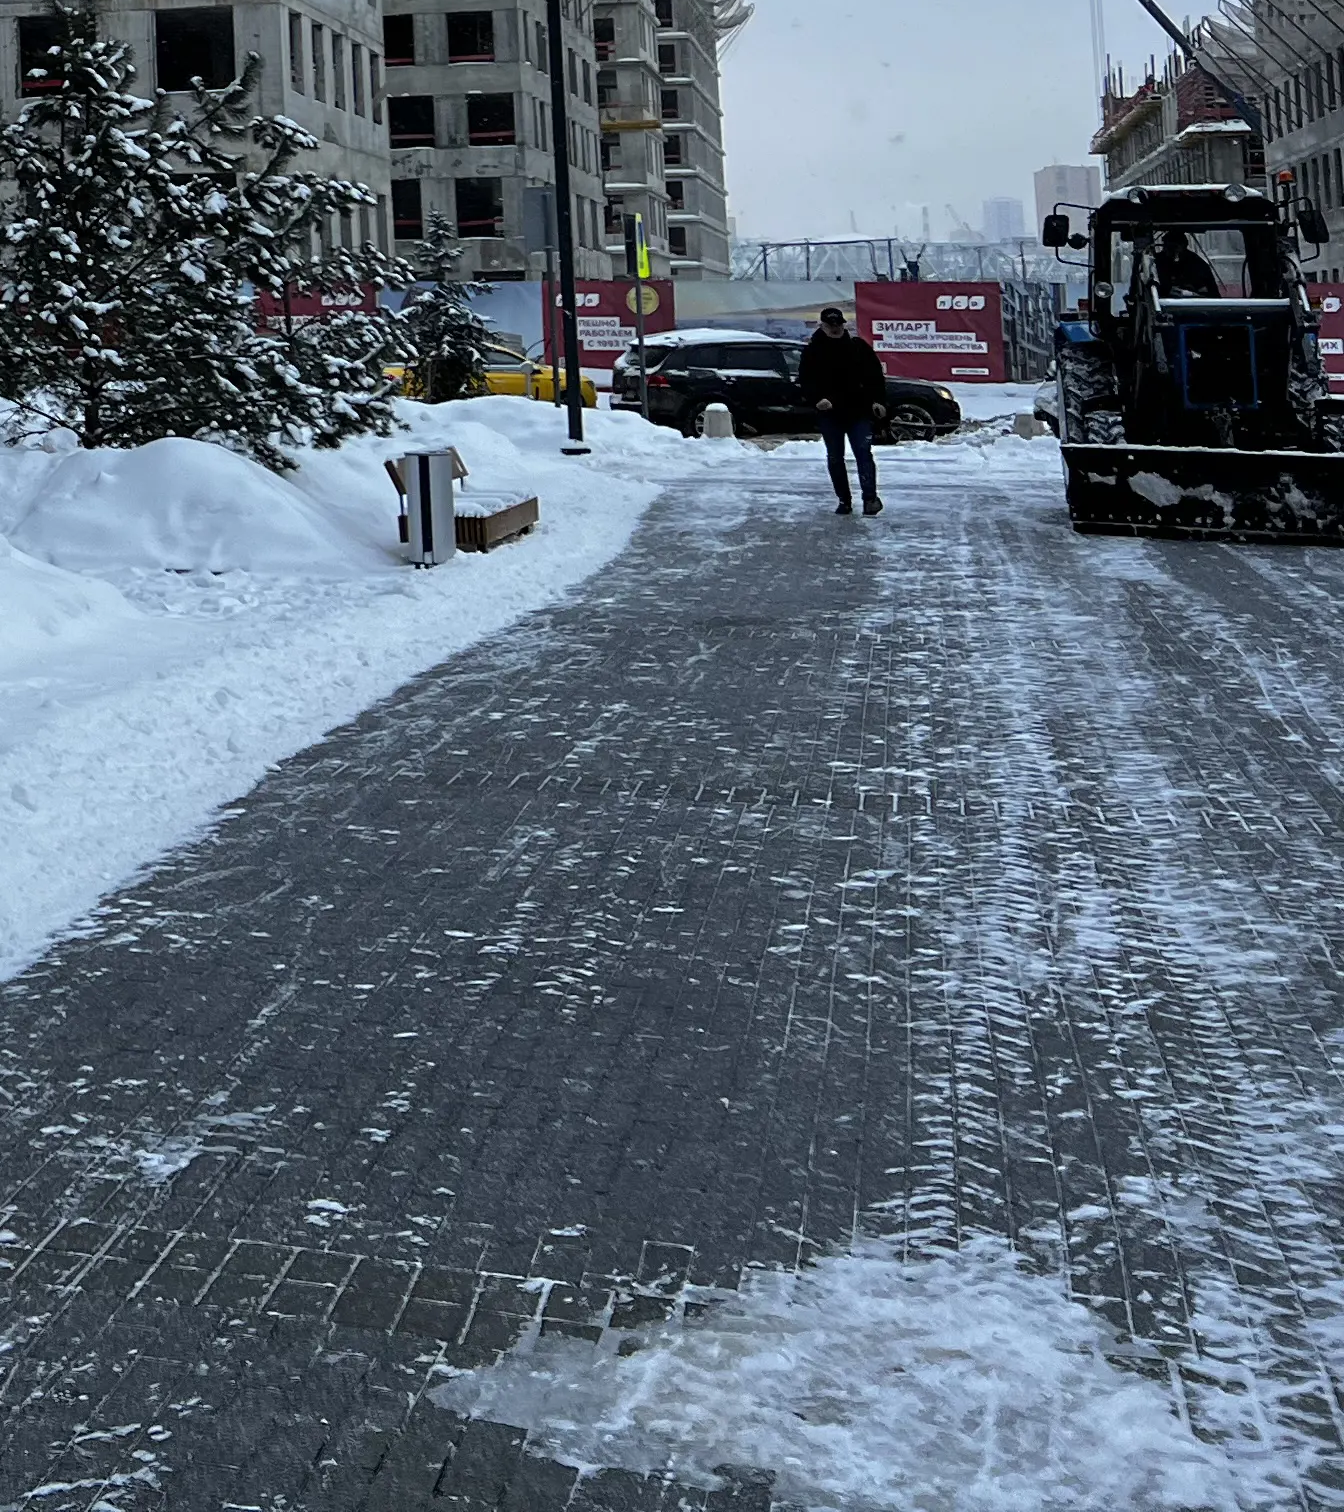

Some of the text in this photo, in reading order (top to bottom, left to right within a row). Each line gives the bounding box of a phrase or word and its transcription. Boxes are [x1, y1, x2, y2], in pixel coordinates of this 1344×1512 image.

[576, 319, 616, 327] ПЕШНО
[876, 322, 931, 331] ЗИЛАРТ
[579, 329, 633, 337] РАБОТАЕМ
[893, 333, 928, 341] НОВЫЙ
[931, 334, 973, 342] УРОВЕНЬ
[876, 341, 985, 350] ГРАДОСТРОИТЕЛЬСТВА
